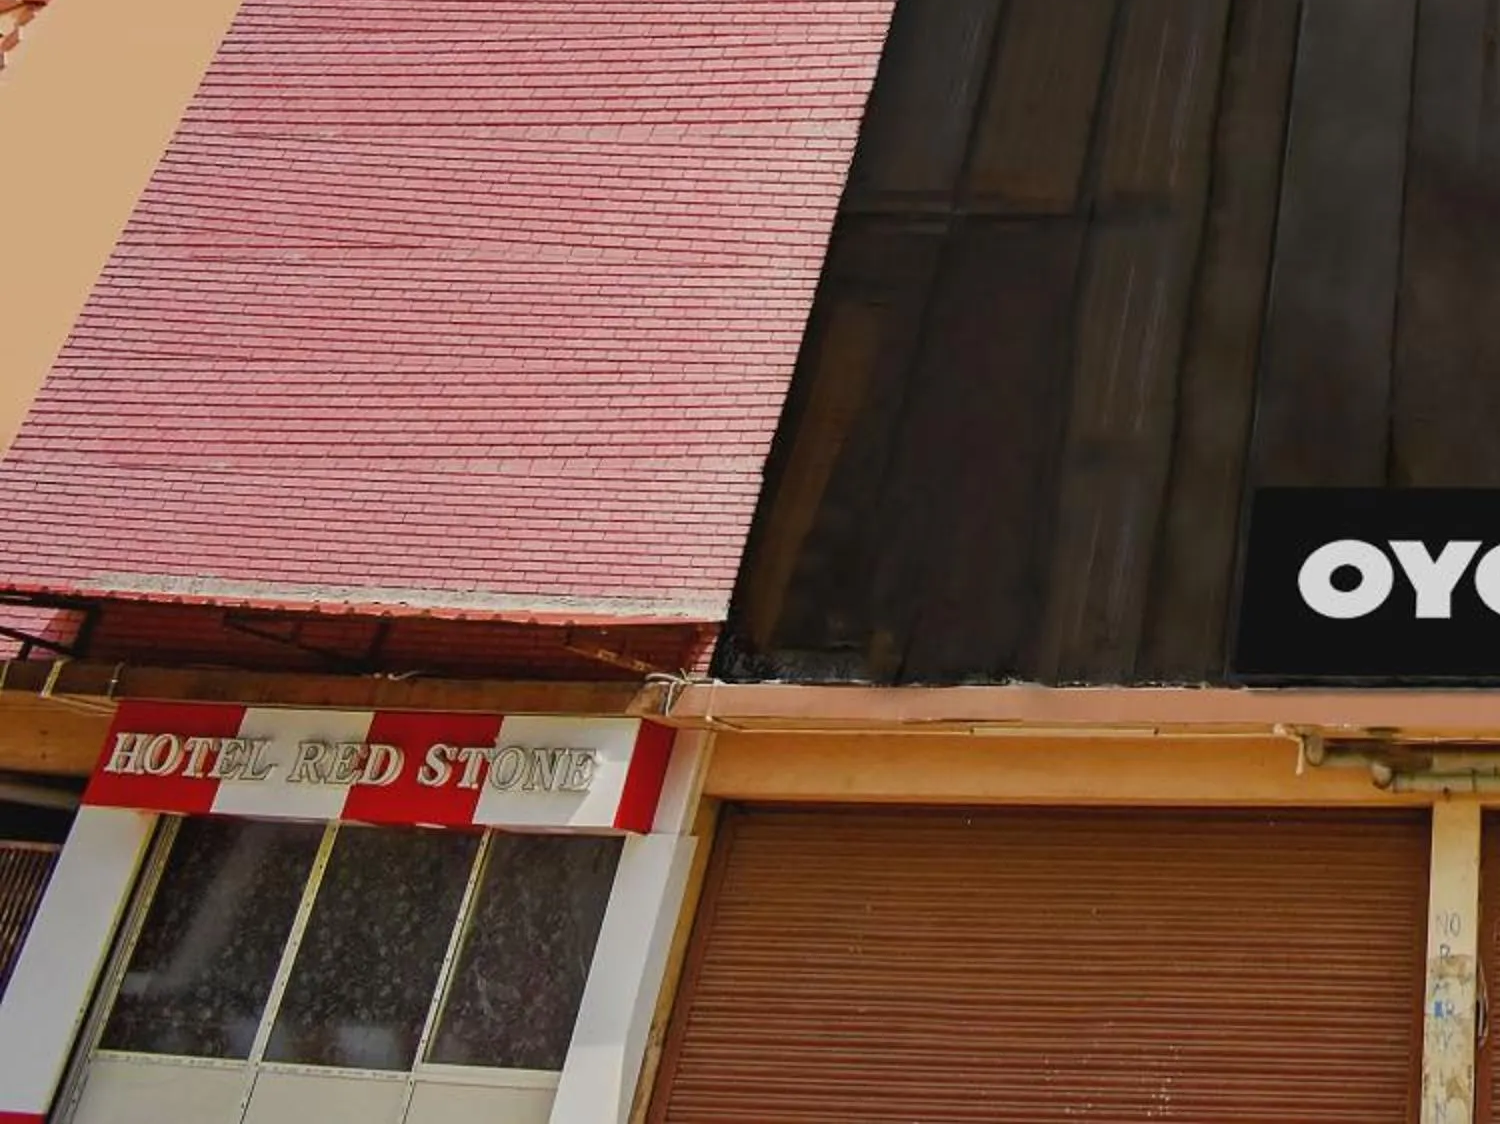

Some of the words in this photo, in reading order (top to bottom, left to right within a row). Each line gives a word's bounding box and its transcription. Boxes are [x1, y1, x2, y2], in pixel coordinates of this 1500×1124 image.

[104, 732, 278, 780] HOTEL
[287, 741, 405, 787] RED
[417, 743, 601, 792] STONE
